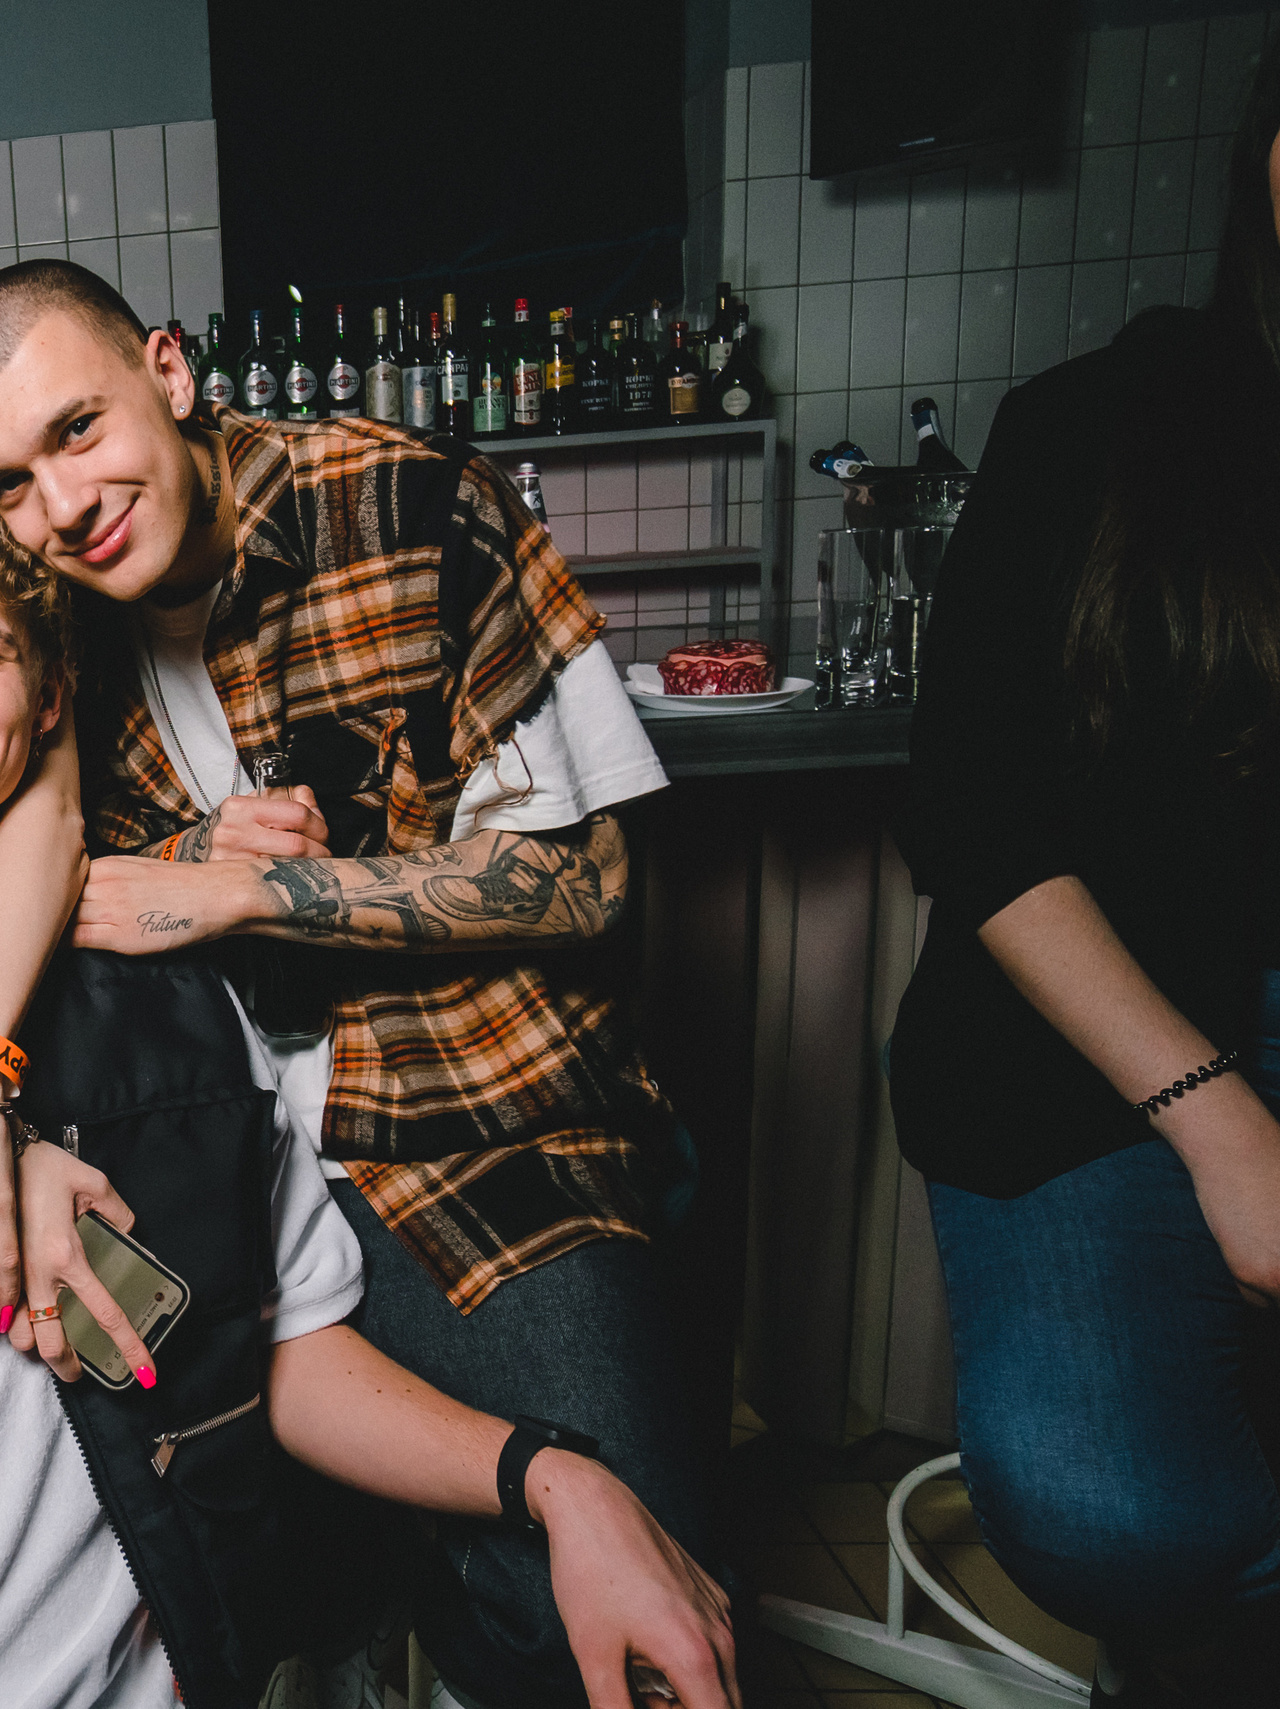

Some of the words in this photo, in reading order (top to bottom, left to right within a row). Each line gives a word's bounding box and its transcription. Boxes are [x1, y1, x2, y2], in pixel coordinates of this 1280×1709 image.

[287, 381, 317, 390] MARTINI
[330, 377, 358, 387] MARTINI
[205, 387, 233, 396] MARTINI
[248, 384, 276, 392] MARTINI
[137, 911, 193, 937] Future
